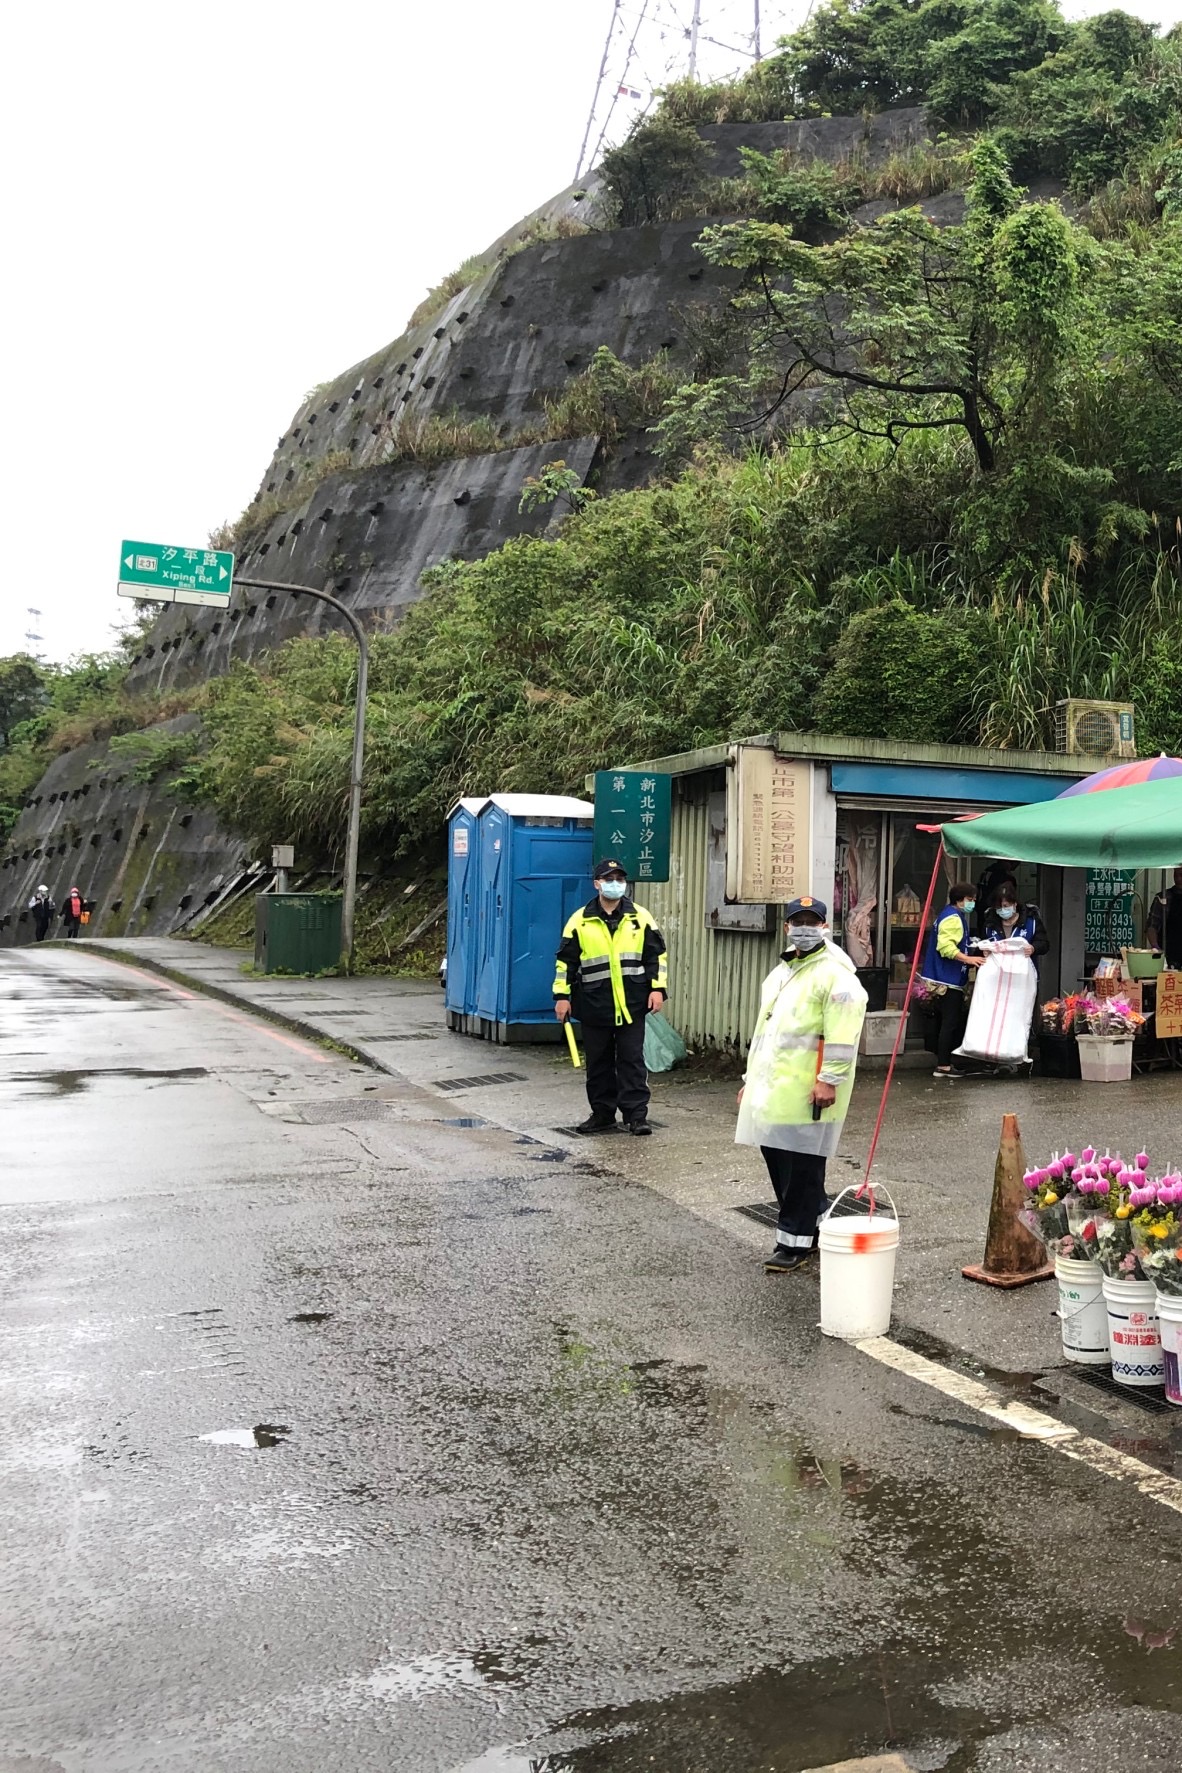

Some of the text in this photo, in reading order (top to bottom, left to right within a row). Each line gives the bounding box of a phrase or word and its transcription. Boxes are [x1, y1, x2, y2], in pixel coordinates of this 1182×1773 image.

[162, 547, 218, 567] 汐平路
[162, 570, 214, 585] Xiping Rd.
[638, 777, 657, 878] 新北市汐止區
